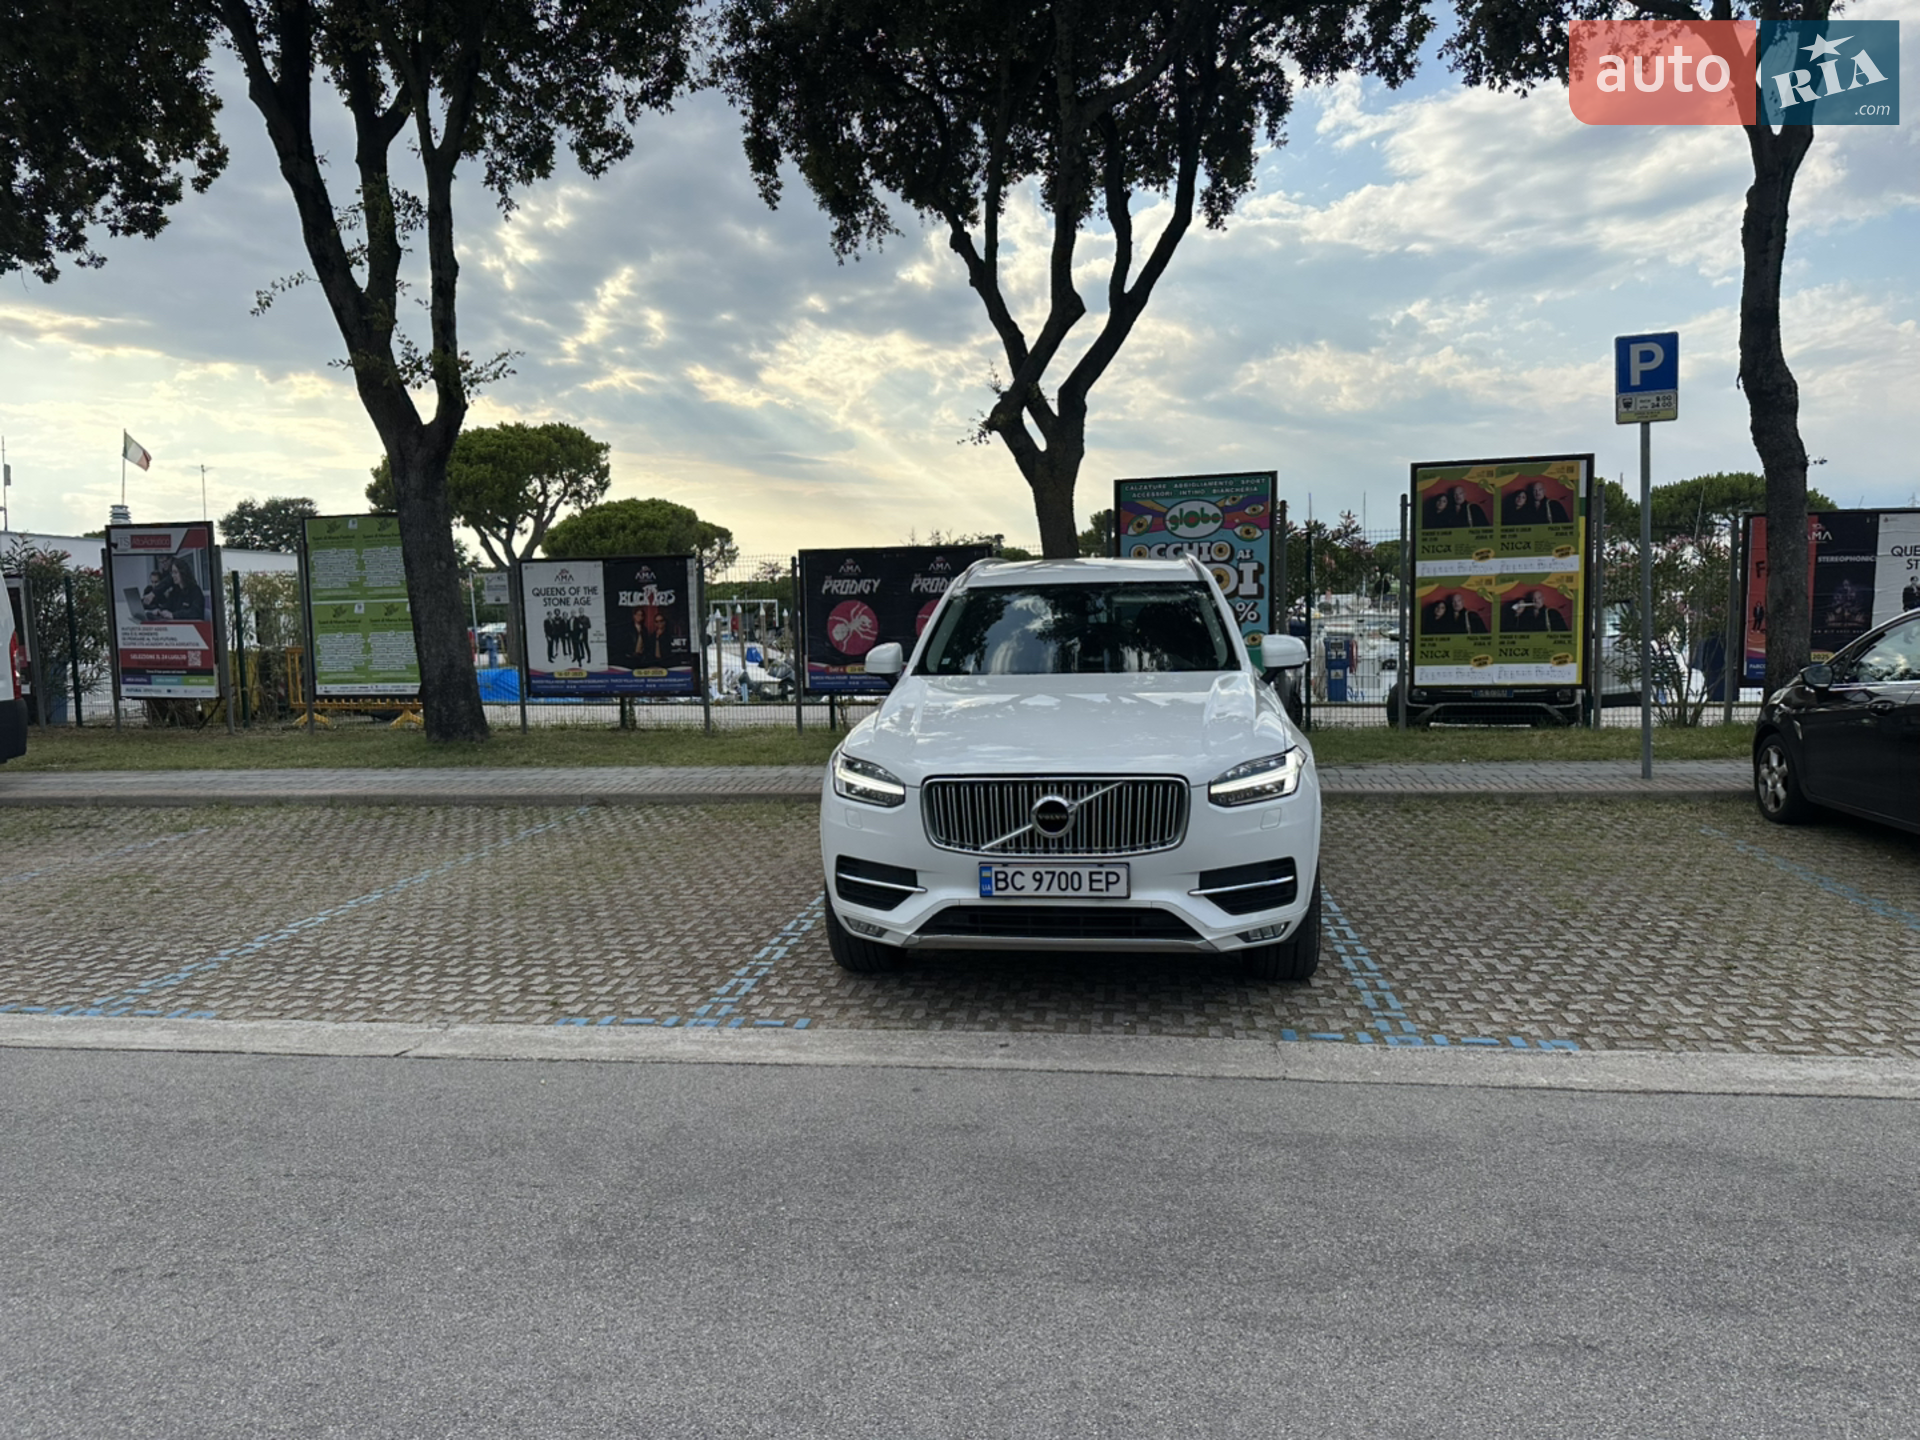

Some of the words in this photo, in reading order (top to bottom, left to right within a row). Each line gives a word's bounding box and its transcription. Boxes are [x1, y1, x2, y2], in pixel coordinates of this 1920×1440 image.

[1629, 342, 1664, 386] P
[1125, 483, 1167, 491] CALZATURE
[1174, 480, 1234, 489] ABBIGLIAMENTO
[1212, 486, 1258, 494] BIANCHERIA
[1130, 541, 1231, 562] OCCHIO
[1236, 549, 1251, 560] AI
[532, 586, 566, 597] QUEENS
[568, 586, 580, 596] OF
[583, 586, 598, 595] THE
[822, 578, 881, 594] PRODIGY
[543, 597, 571, 607] STONE
[573, 596, 592, 606] AGE
[671, 638, 687, 646] JET
[994, 870, 1026, 892] BC
[1032, 870, 1082, 892] 9700
[1088, 871, 1120, 892] EP
